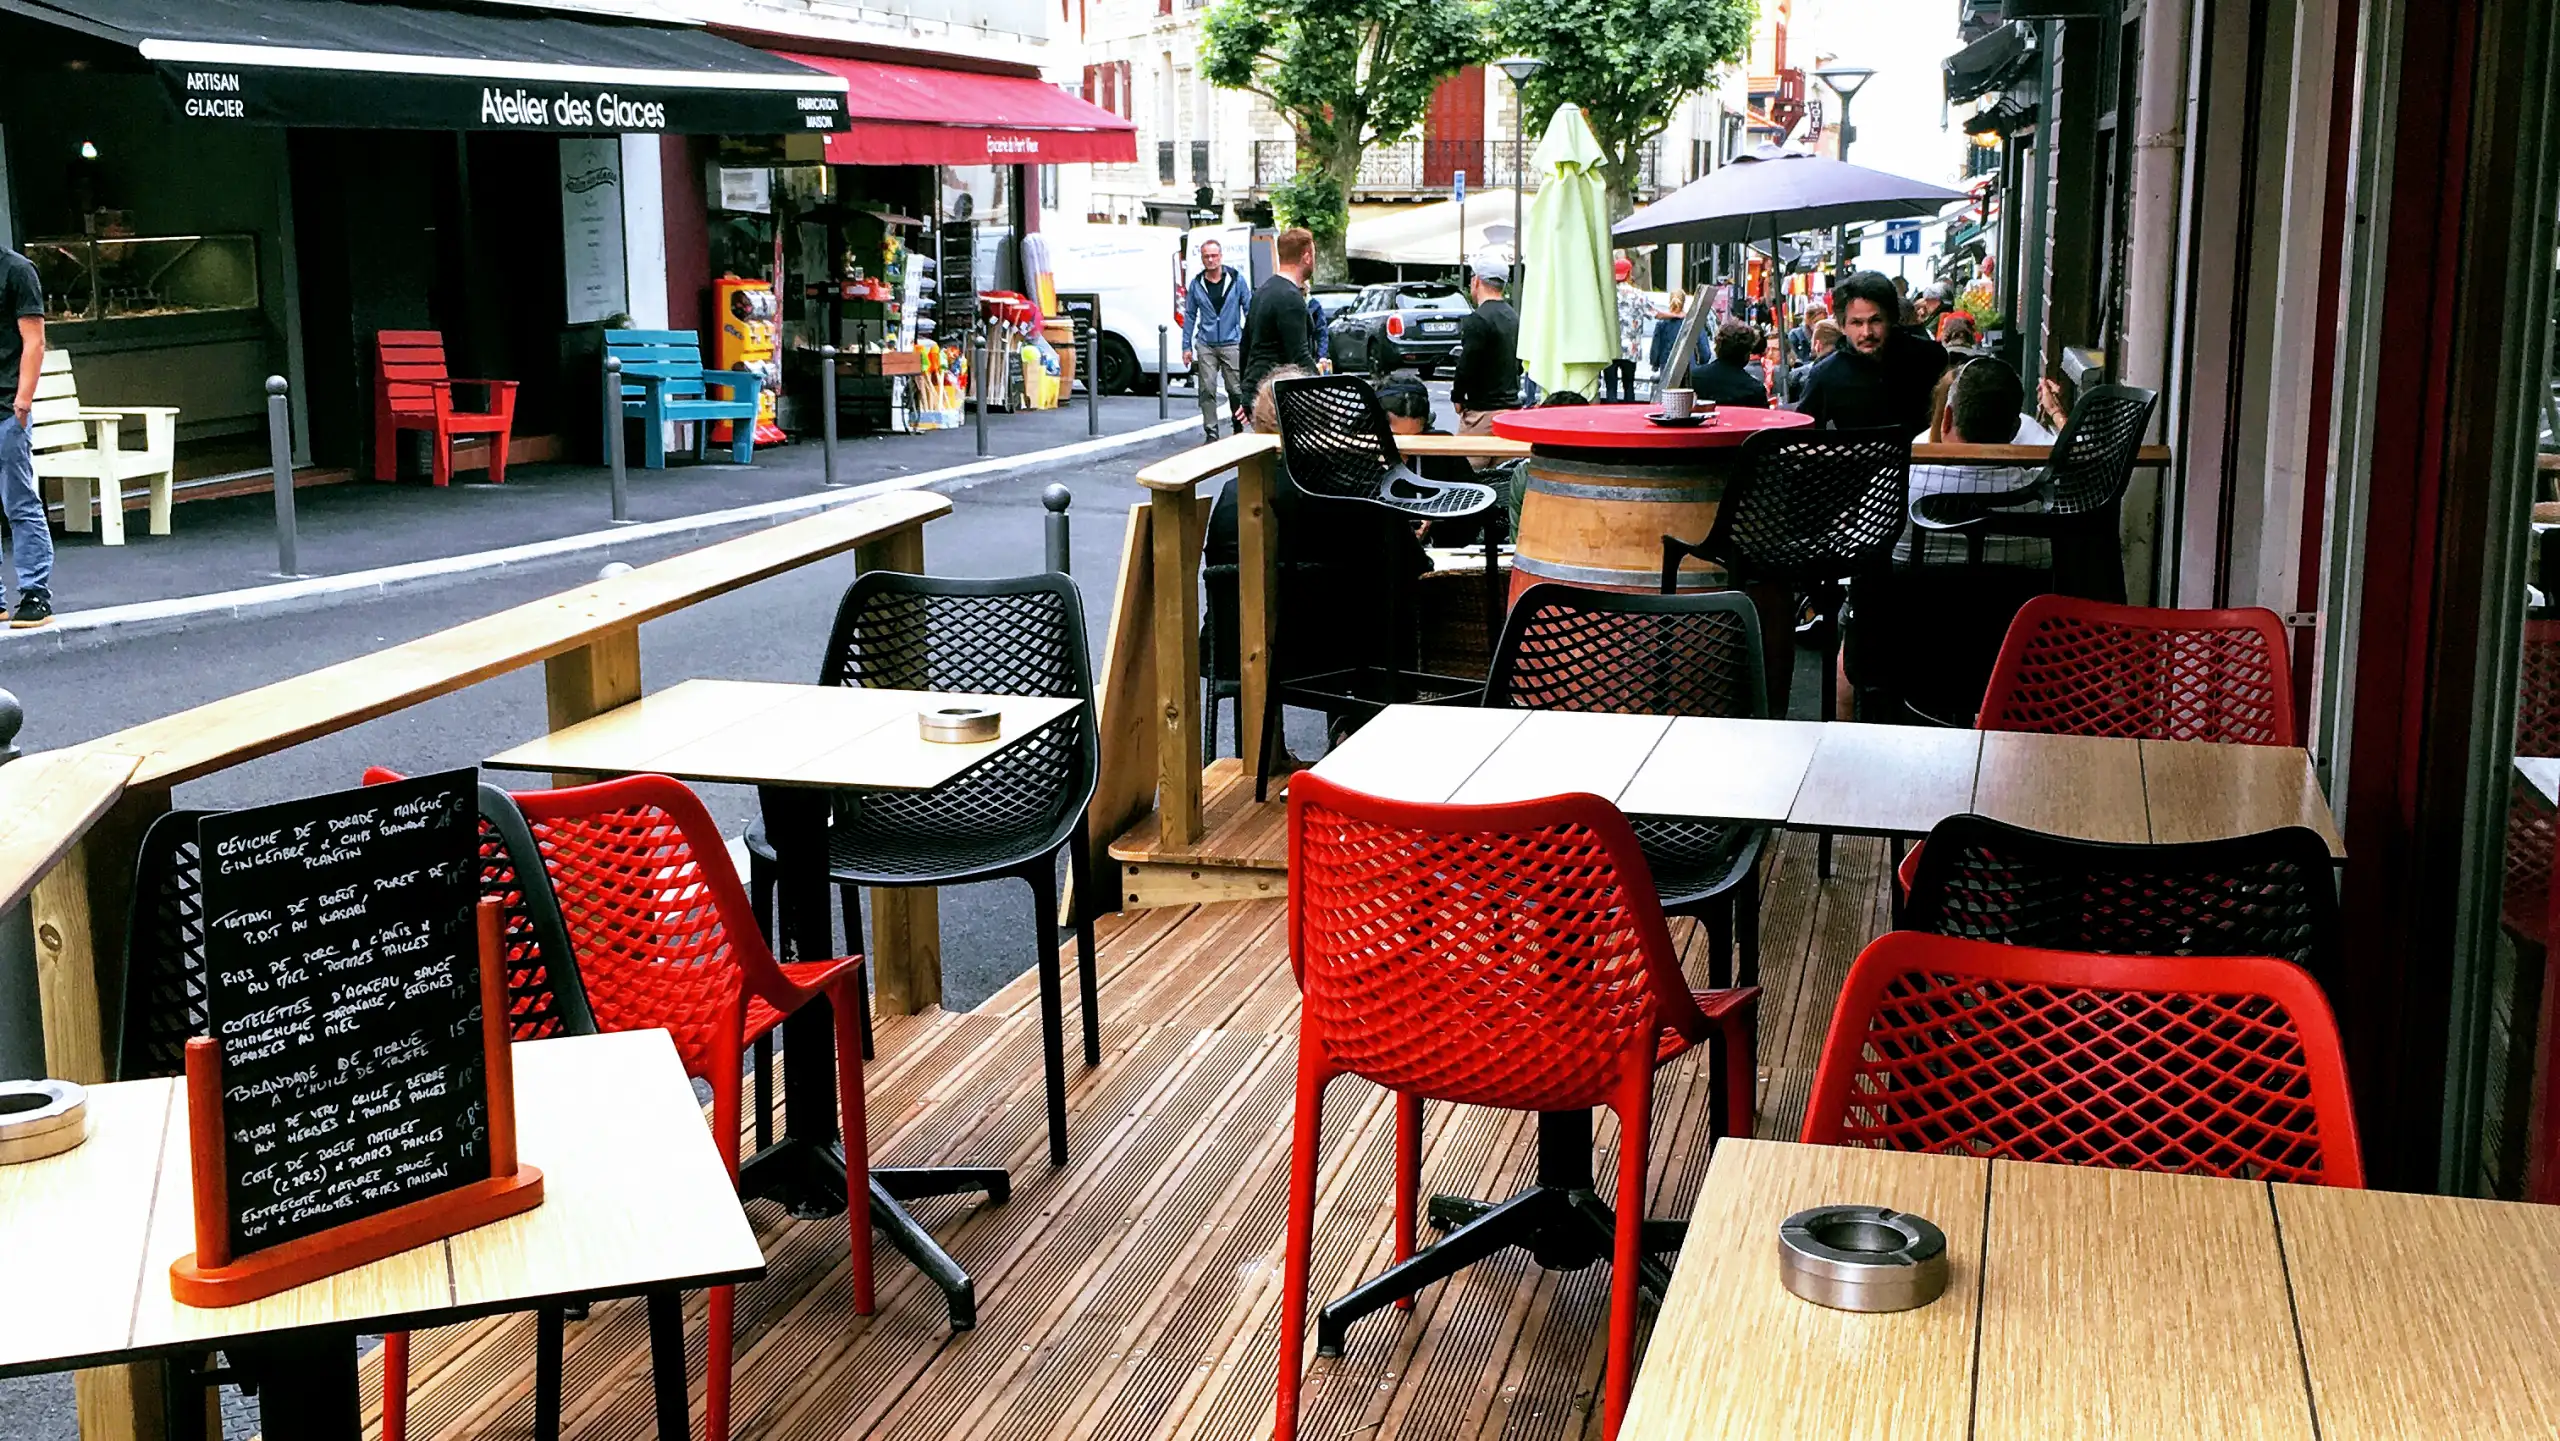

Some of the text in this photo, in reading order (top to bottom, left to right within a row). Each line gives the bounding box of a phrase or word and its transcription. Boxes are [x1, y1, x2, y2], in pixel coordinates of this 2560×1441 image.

[187, 73, 240, 92] ARTISAN
[185, 98, 244, 118] GLACIER
[482, 87, 666, 129] Atelier des Glaces
[797, 97, 839, 111] FABRICATION
[805, 115, 834, 128] MAISON
[293, 820, 317, 840] DE
[394, 791, 451, 817] MANGUE
[221, 842, 310, 875] GINGEMBRE
[340, 829, 371, 845] CHIPS
[380, 816, 429, 836] BANANE
[303, 846, 362, 870] PLANTIN
[211, 909, 272, 929] TATAKI
[287, 897, 309, 915] DE
[428, 862, 449, 878] DE
[292, 919, 308, 933] AU
[319, 903, 367, 925] WASABI
[221, 968, 256, 987] RIBS
[268, 957, 291, 974] DE
[302, 945, 340, 964] PORC
[248, 981, 269, 994] AU
[323, 949, 374, 972] POMMES
[381, 934, 430, 957] PAILLES
[222, 996, 313, 1033] COTELETTES
[413, 955, 456, 980] SAUCE
[298, 1033, 314, 1045] AU
[325, 1016, 360, 1037] MIEL
[225, 1029, 424, 1102] BRANDADE DE MORUE
[296, 1070, 349, 1099] L'HUILE
[355, 1060, 376, 1079] DE
[381, 1038, 436, 1068] TRUFFE
[254, 1140, 276, 1155] AUX
[286, 1117, 340, 1143] HERBES
[361, 1098, 402, 1120] POMMES
[408, 1083, 448, 1104] PAILLES
[284, 1111, 304, 1128] DE
[310, 1103, 340, 1119] VEAU
[241, 1162, 279, 1187] COTE
[284, 1152, 309, 1173] DE
[316, 1138, 356, 1161] BOEUF
[348, 1144, 392, 1169] POMMES
[406, 1162, 448, 1188] MAISON
[241, 1189, 322, 1224] ENTRECOTE
[395, 1151, 436, 1176] SAUCE
